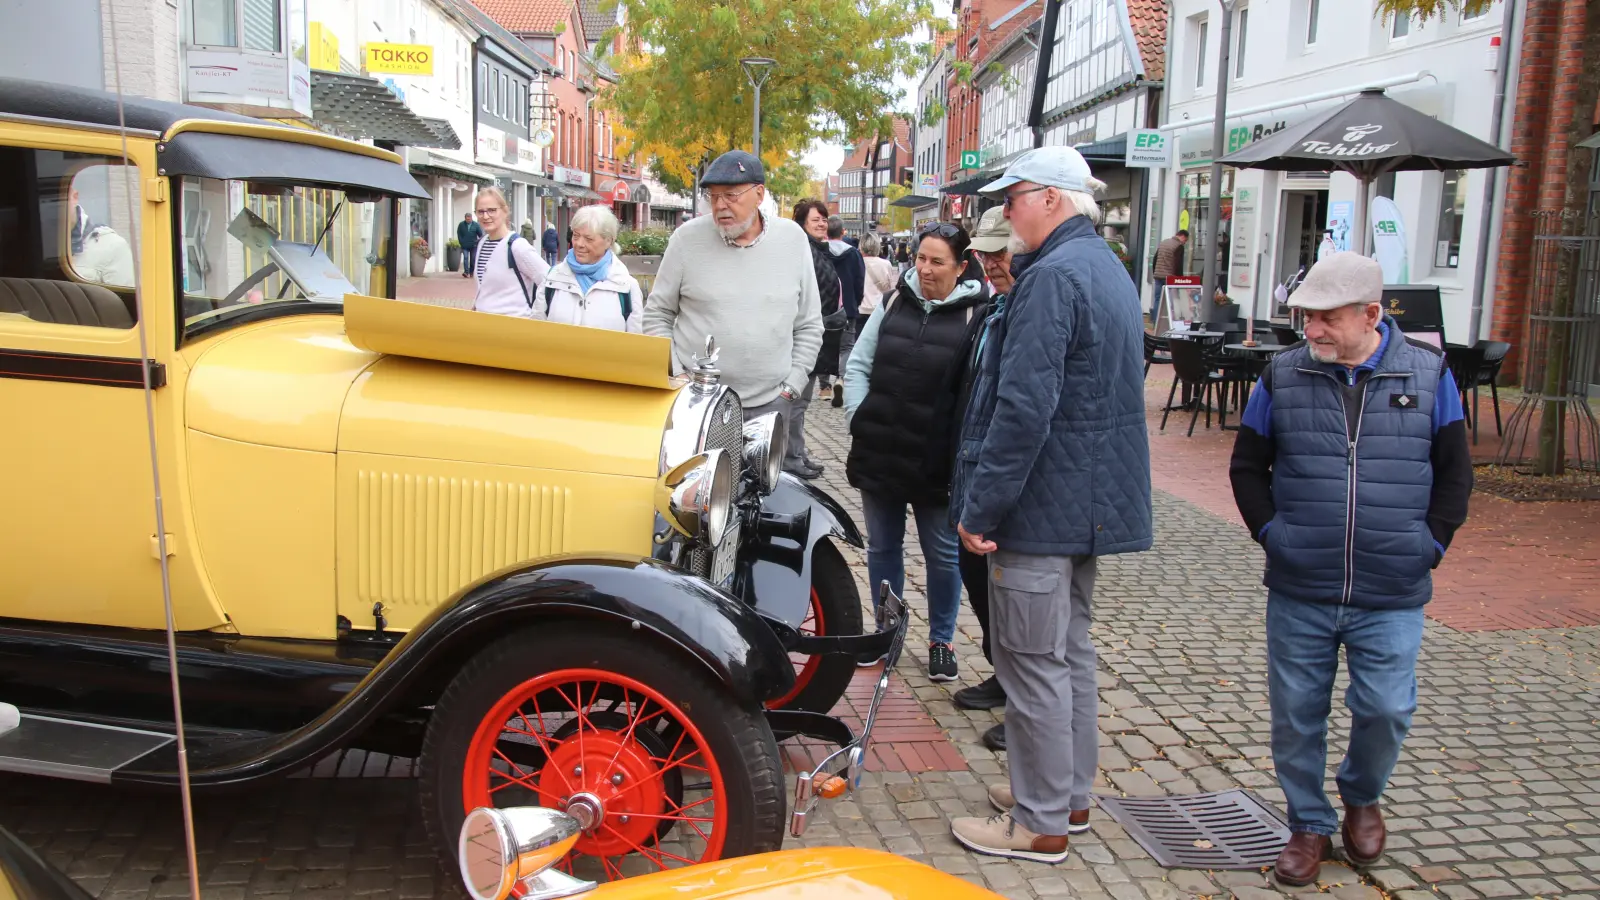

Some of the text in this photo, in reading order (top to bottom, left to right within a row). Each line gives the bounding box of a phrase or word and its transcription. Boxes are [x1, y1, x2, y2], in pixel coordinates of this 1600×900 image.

[195, 70, 232, 78] Kanzlei-KT
[1135, 133, 1165, 148] EP:
[1302, 141, 1398, 156] Tchibo
[965, 154, 976, 165] D
